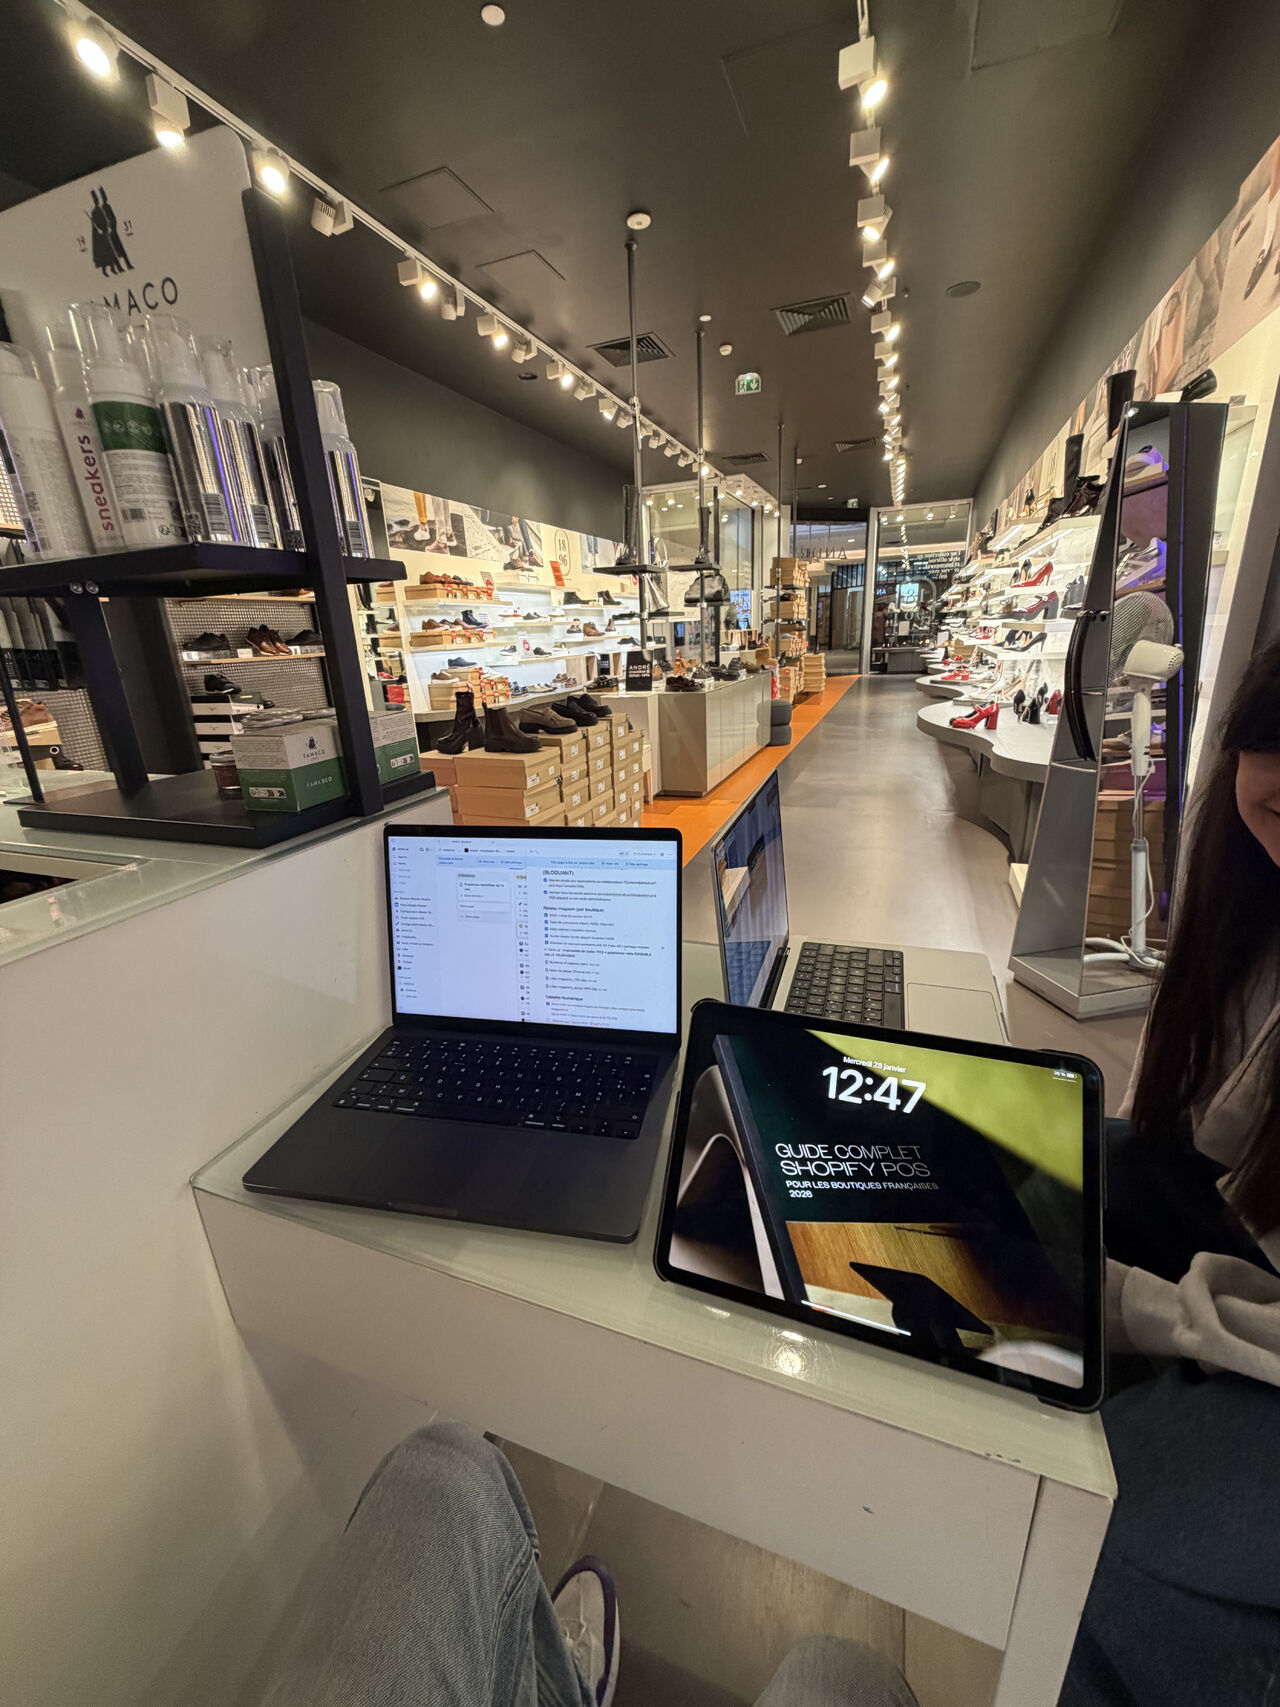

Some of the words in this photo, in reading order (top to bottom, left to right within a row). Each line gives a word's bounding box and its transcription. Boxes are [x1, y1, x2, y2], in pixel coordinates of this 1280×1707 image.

[78, 434, 114, 531] sneakers
[558, 538, 567, 552] 18
[303, 749, 326, 759] FAMACO
[843, 1056, 873, 1067] Mercredi
[873, 1061, 882, 1070] 28
[883, 1063, 906, 1073] janvier
[822, 1066, 926, 1114] 12:47
[775, 1143, 833, 1159] GUIDE
[834, 1145, 921, 1160] COMPLET
[780, 1160, 875, 1176] SHOPIFY
[881, 1162, 931, 1177] POS
[785, 1180, 812, 1189] POUR
[812, 1181, 830, 1189] LES
[831, 1181, 882, 1190] BOUTIQUES
[883, 1182, 939, 1191] FRANÇAISES
